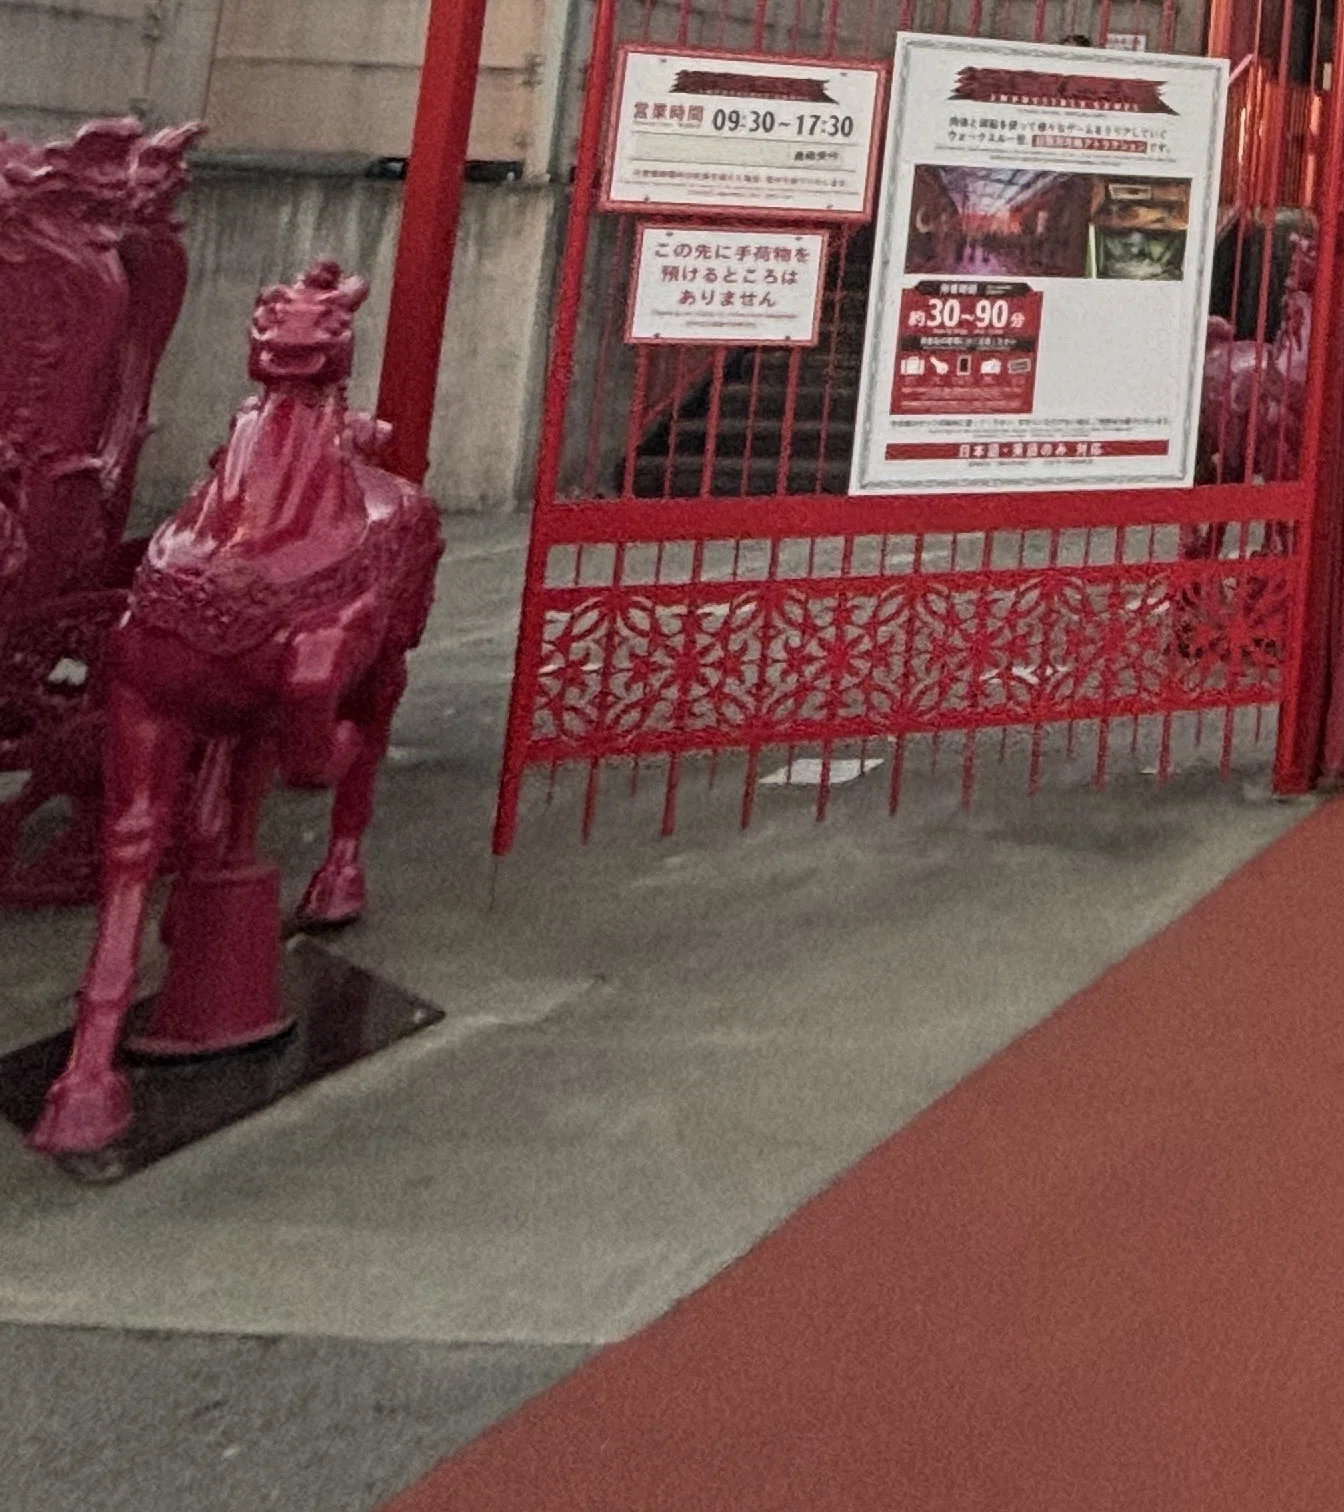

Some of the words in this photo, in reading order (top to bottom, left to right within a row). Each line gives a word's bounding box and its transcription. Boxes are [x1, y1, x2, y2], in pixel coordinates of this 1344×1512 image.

[633, 101, 704, 123] 営業時間
[654, 242, 811, 264] この先に手荷物を
[661, 264, 798, 286] 預けるところは
[677, 288, 777, 308] ありません
